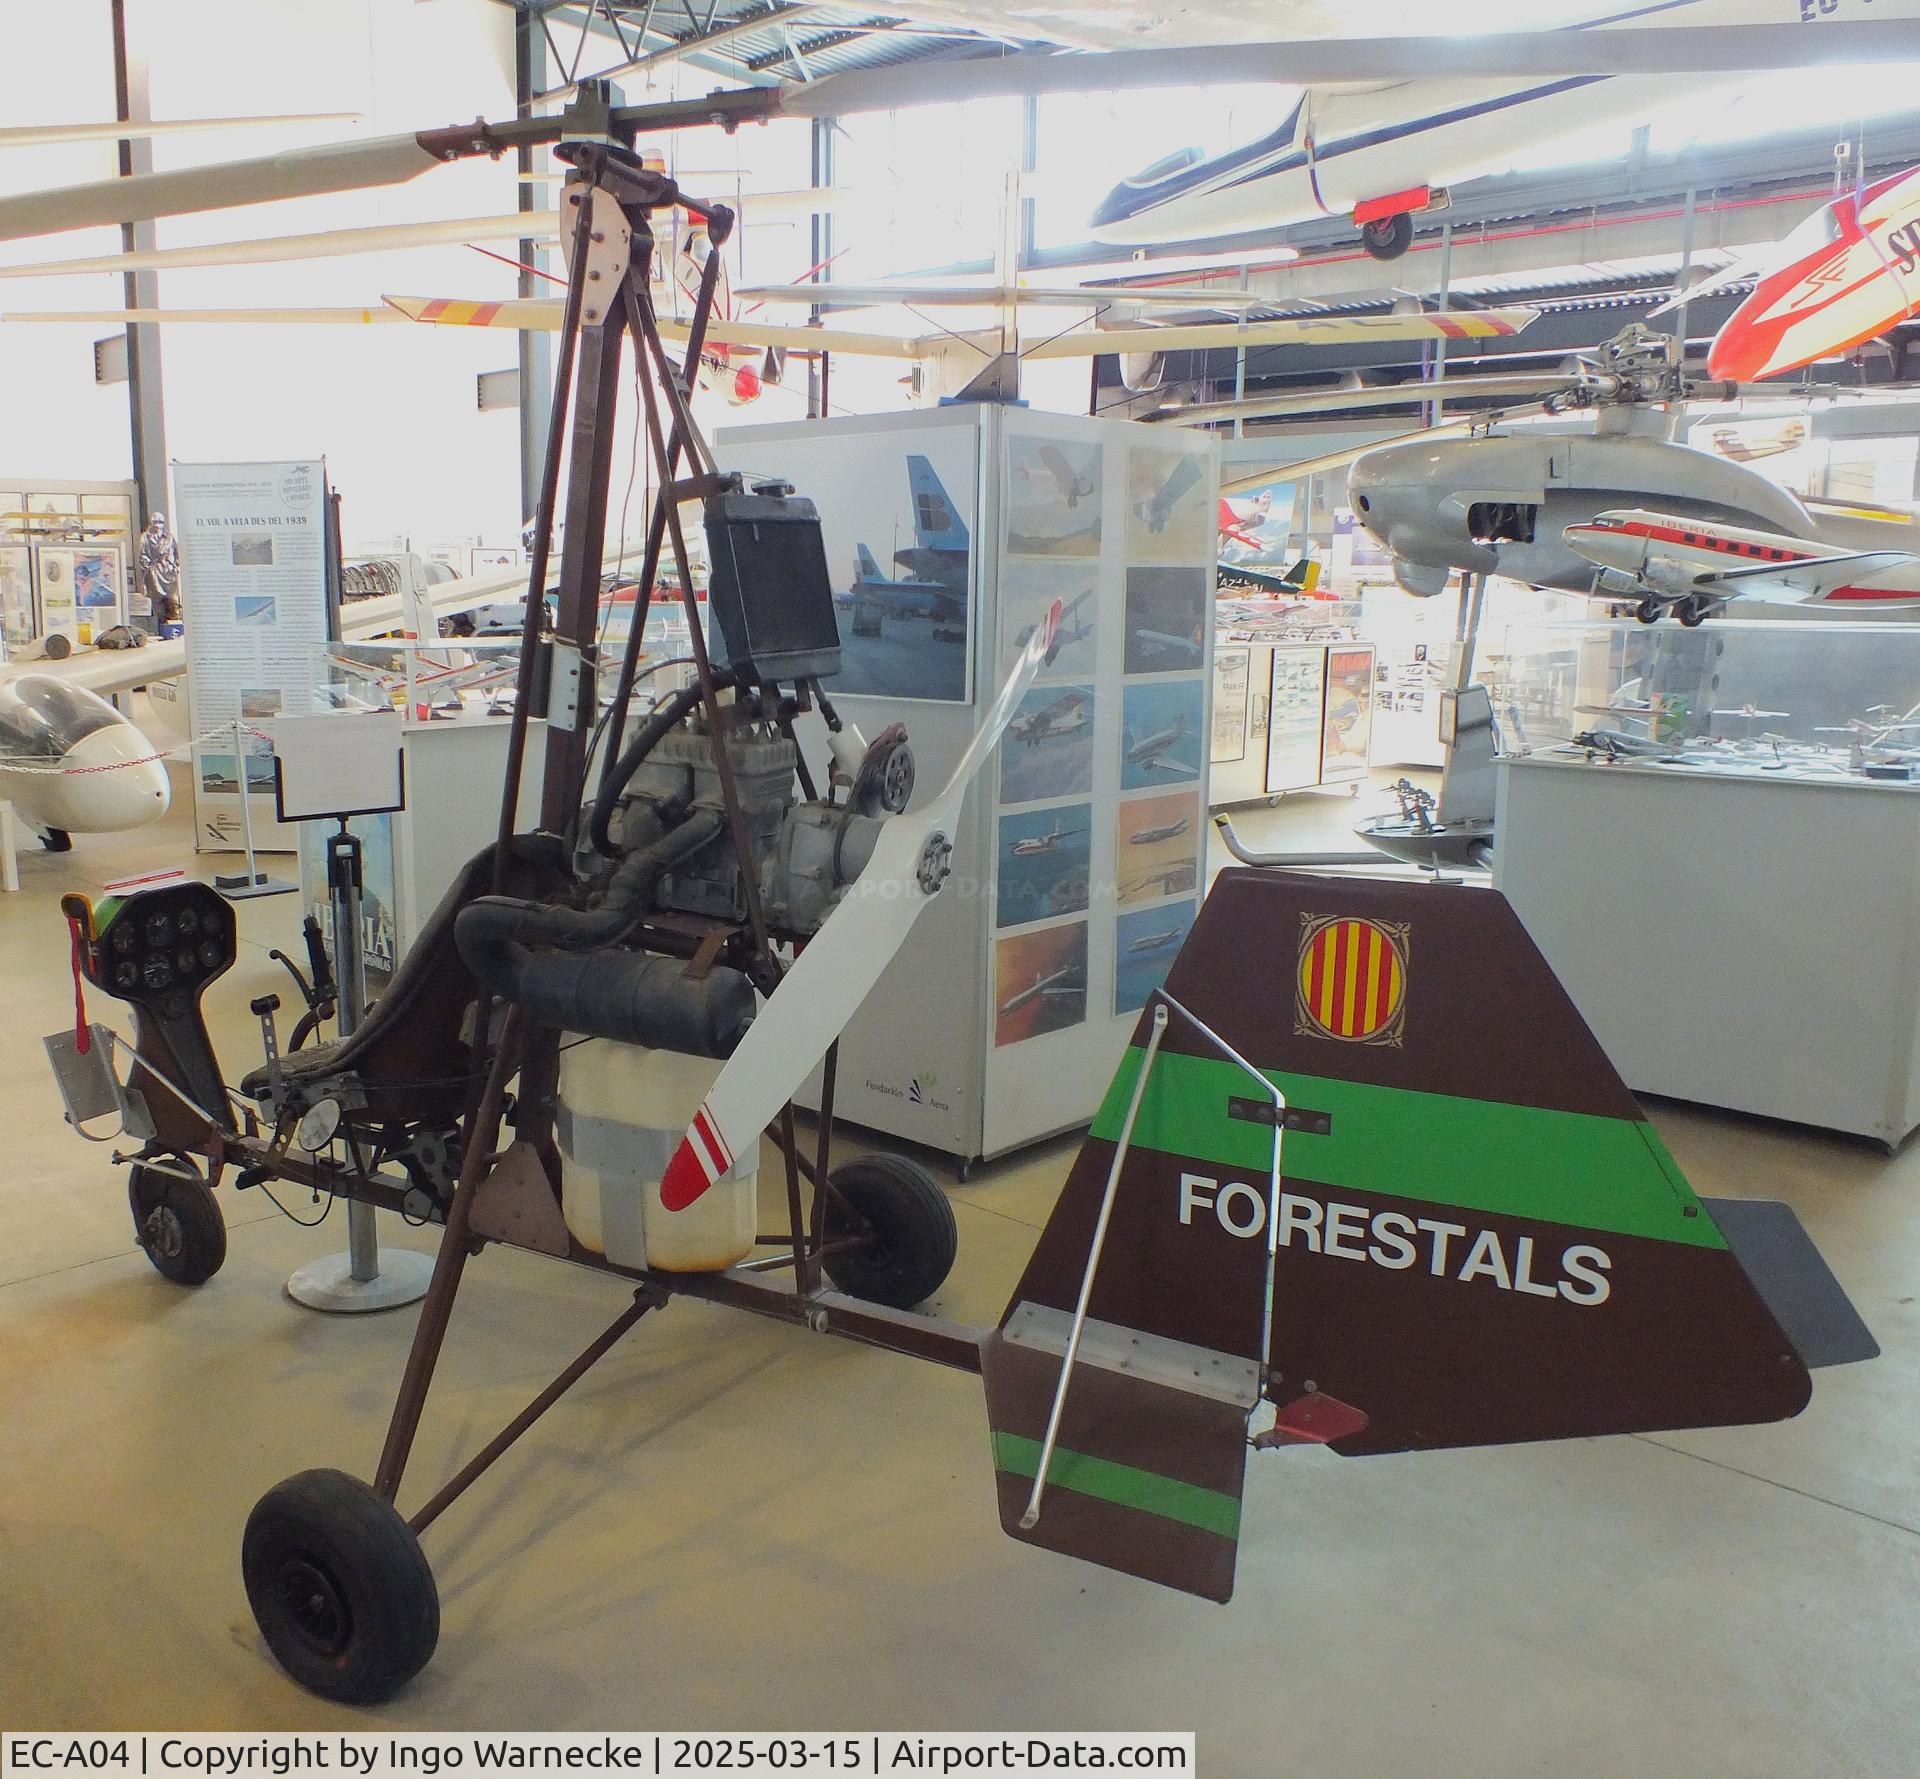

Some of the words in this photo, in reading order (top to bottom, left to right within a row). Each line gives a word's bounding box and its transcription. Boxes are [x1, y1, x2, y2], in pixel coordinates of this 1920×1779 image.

[196, 518, 206, 526] EL
[207, 518, 221, 526] VOL
[251, 517, 266, 526] DES
[269, 517, 282, 525] DEL
[286, 516, 307, 525] 1939
[1661, 520, 1718, 536] IBERIA
[865, 1080, 904, 1098] Fundación
[929, 1098, 949, 1111] Aena
[1179, 1172, 1612, 1306] FORESTALS
